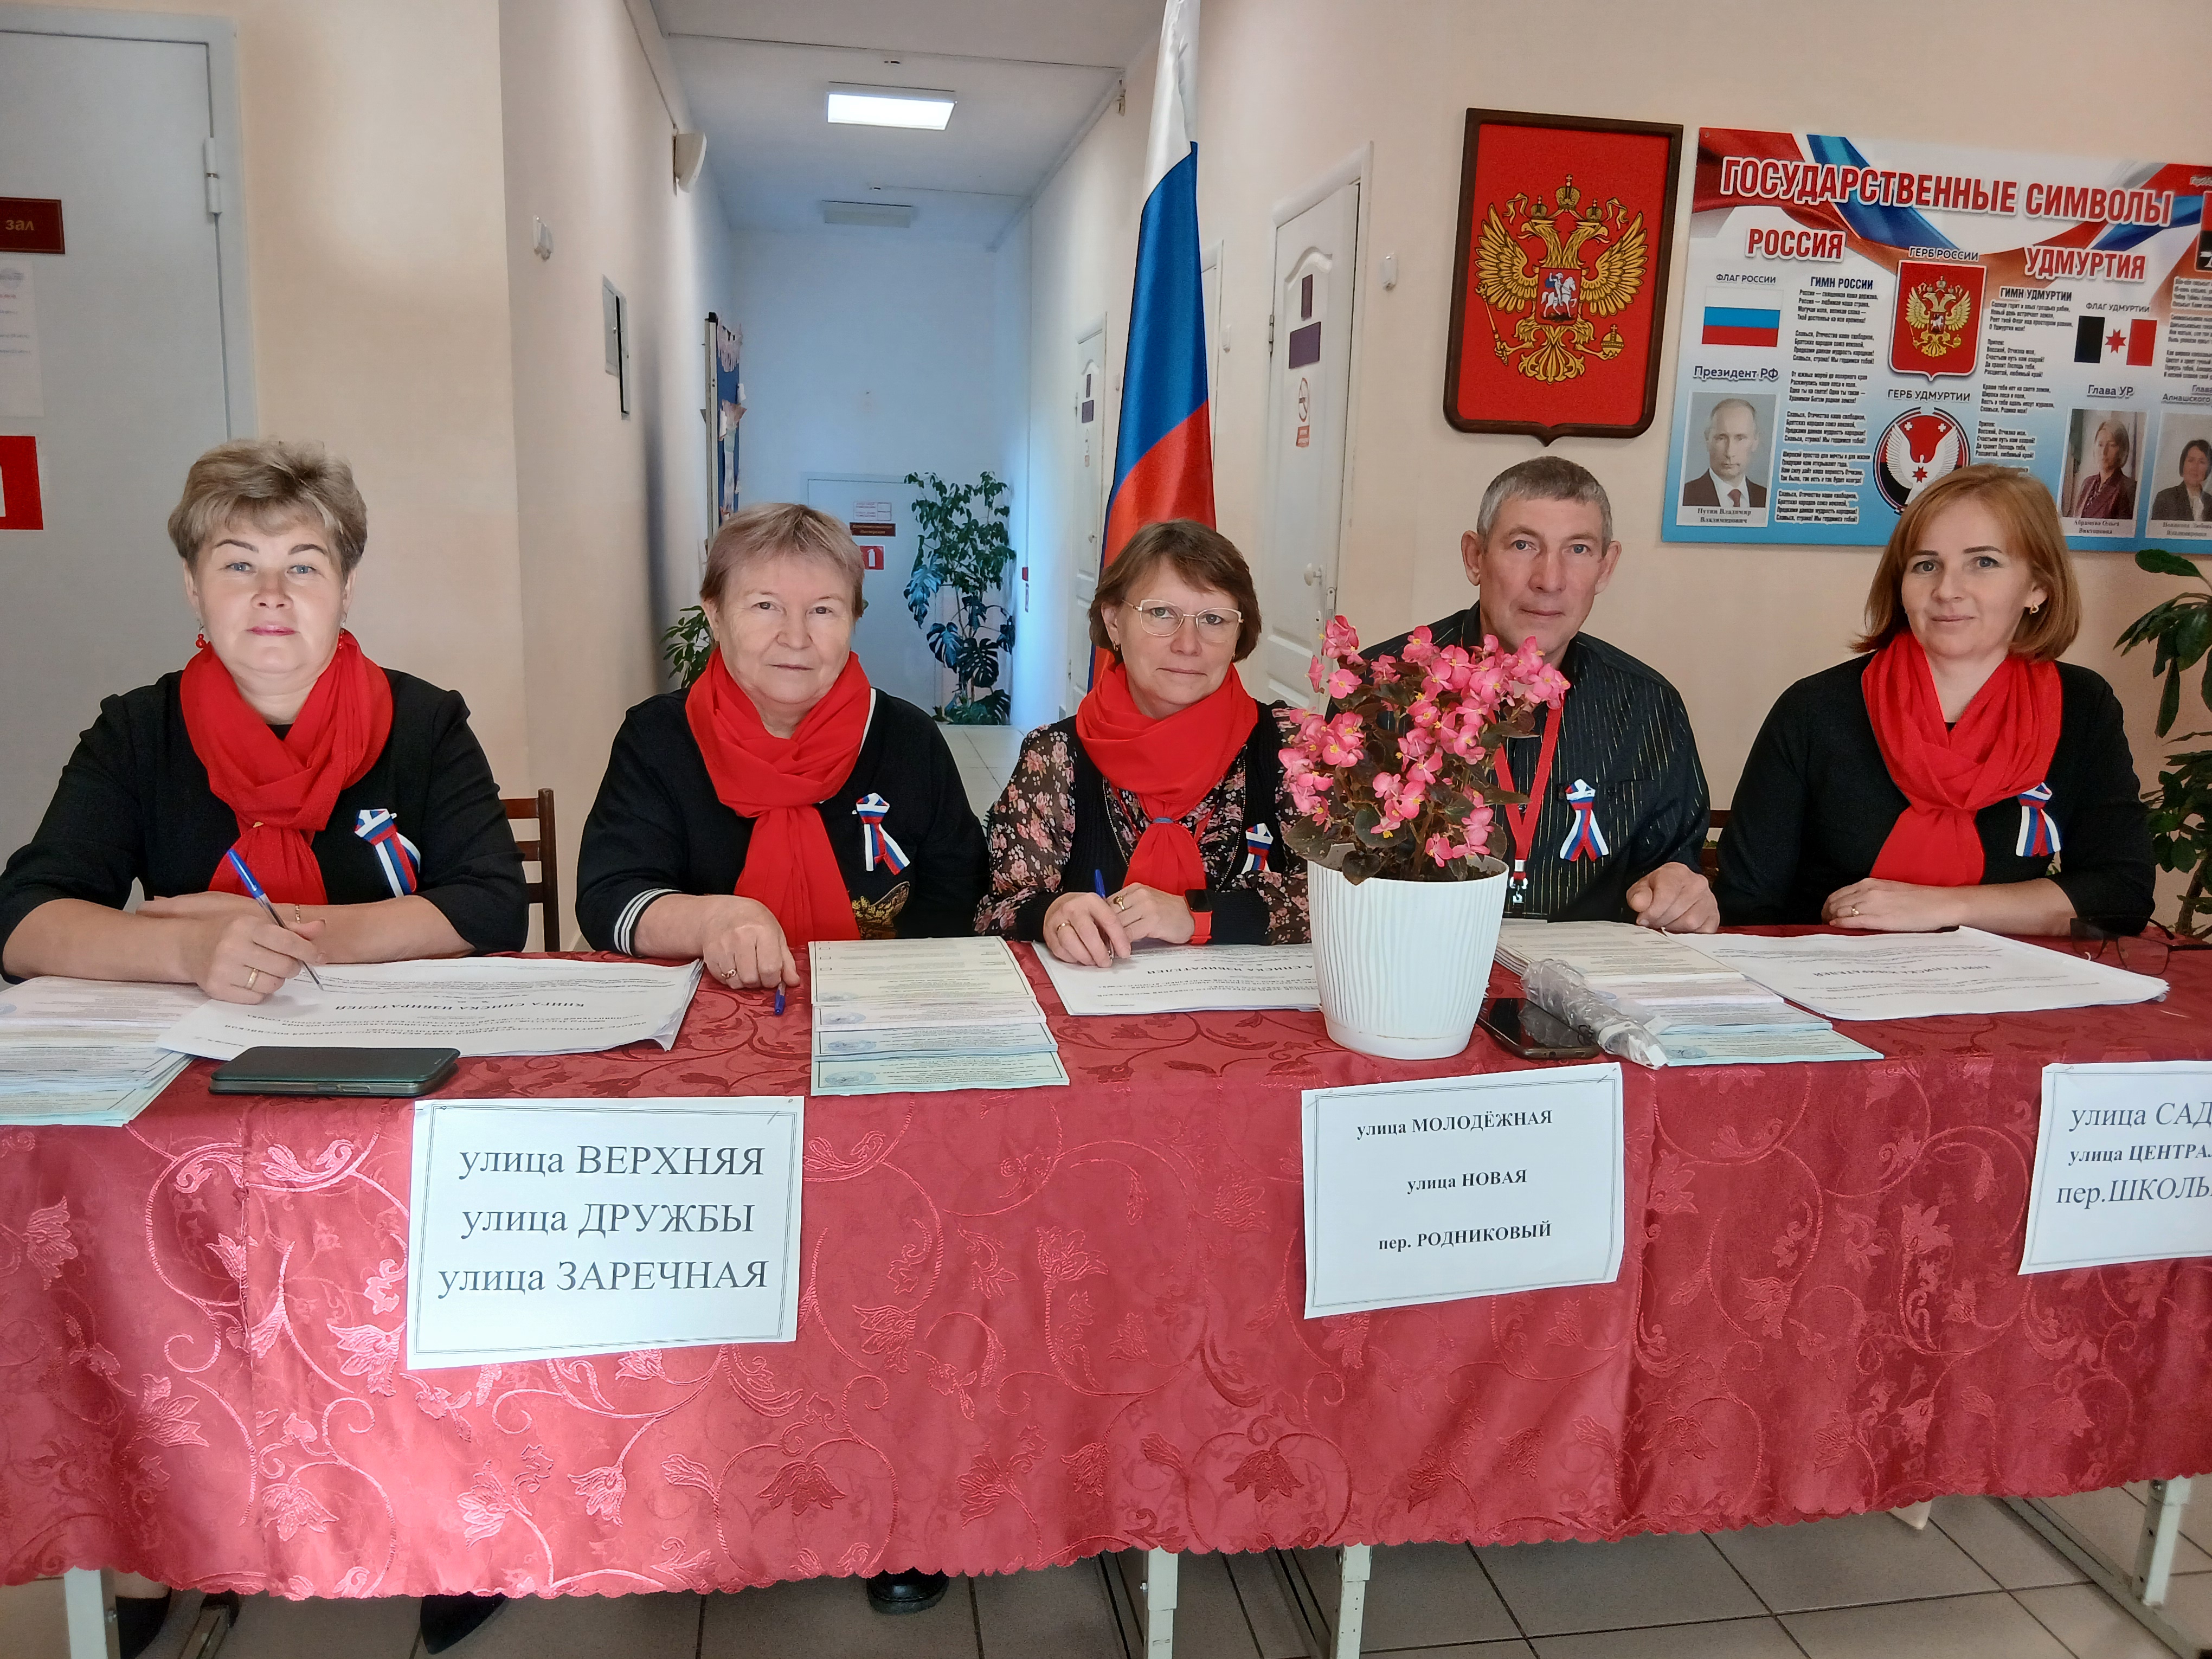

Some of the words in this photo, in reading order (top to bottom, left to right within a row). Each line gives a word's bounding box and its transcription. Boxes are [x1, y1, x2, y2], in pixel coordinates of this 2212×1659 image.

[1723, 159, 2017, 213] ГОСУДАРСТВЕННЫЕ
[2026, 183, 2174, 224] СИМВОЛЫ
[5, 220, 34, 231] зал
[1748, 228, 1843, 259] РОССИЯ
[1909, 248, 1934, 258] ГЕРБ
[1937, 249, 1978, 261] РОССИИ
[2027, 247, 2146, 280] УДМУРТИЯ
[1716, 273, 1740, 281] ФЛАГ
[1741, 275, 1776, 284] РОССИИ
[1811, 276, 1836, 287] ГИМН
[1838, 278, 1874, 290] РОССИИ
[2001, 287, 2024, 298] ГИМН
[2027, 290, 2072, 301] УДМУРТИИ
[2109, 304, 2150, 313] УДМУРТИИ
[1694, 365, 1758, 379] Президент
[1760, 368, 1779, 379] РФ
[1888, 389, 1912, 398] ГЕРБ
[1915, 390, 1970, 401] УДМУРТИИ
[2088, 384, 2117, 395] Глава
[2119, 387, 2133, 396] УР
[2162, 393, 2210, 403] Алнашского
[459, 1002, 525, 1011] СПИСКА
[1356, 1123, 1406, 1140] улица
[1412, 1109, 1553, 1132] МОЛОДЁЖНАЯ
[2069, 1108, 2146, 1132] улица
[459, 1150, 565, 1180] улица
[575, 1144, 765, 1176] ВЕРХНЯЯ
[2068, 1149, 2123, 1166] улица
[2129, 1144, 2212, 1163] ЦЕНТРА
[1407, 1176, 1456, 1194] улица
[1462, 1169, 1528, 1187] НОВАЯ
[2056, 1175, 2212, 1210] пер.ШКОЛЬ
[461, 1210, 568, 1239] улица
[577, 1203, 756, 1238] ДРУЖБЫ
[1378, 1237, 1411, 1252] пер.
[1417, 1220, 1552, 1247] РОДНИКОВЫЙ
[438, 1268, 545, 1300] улица
[557, 1261, 769, 1290] ЗАРЕЧНАЯ
